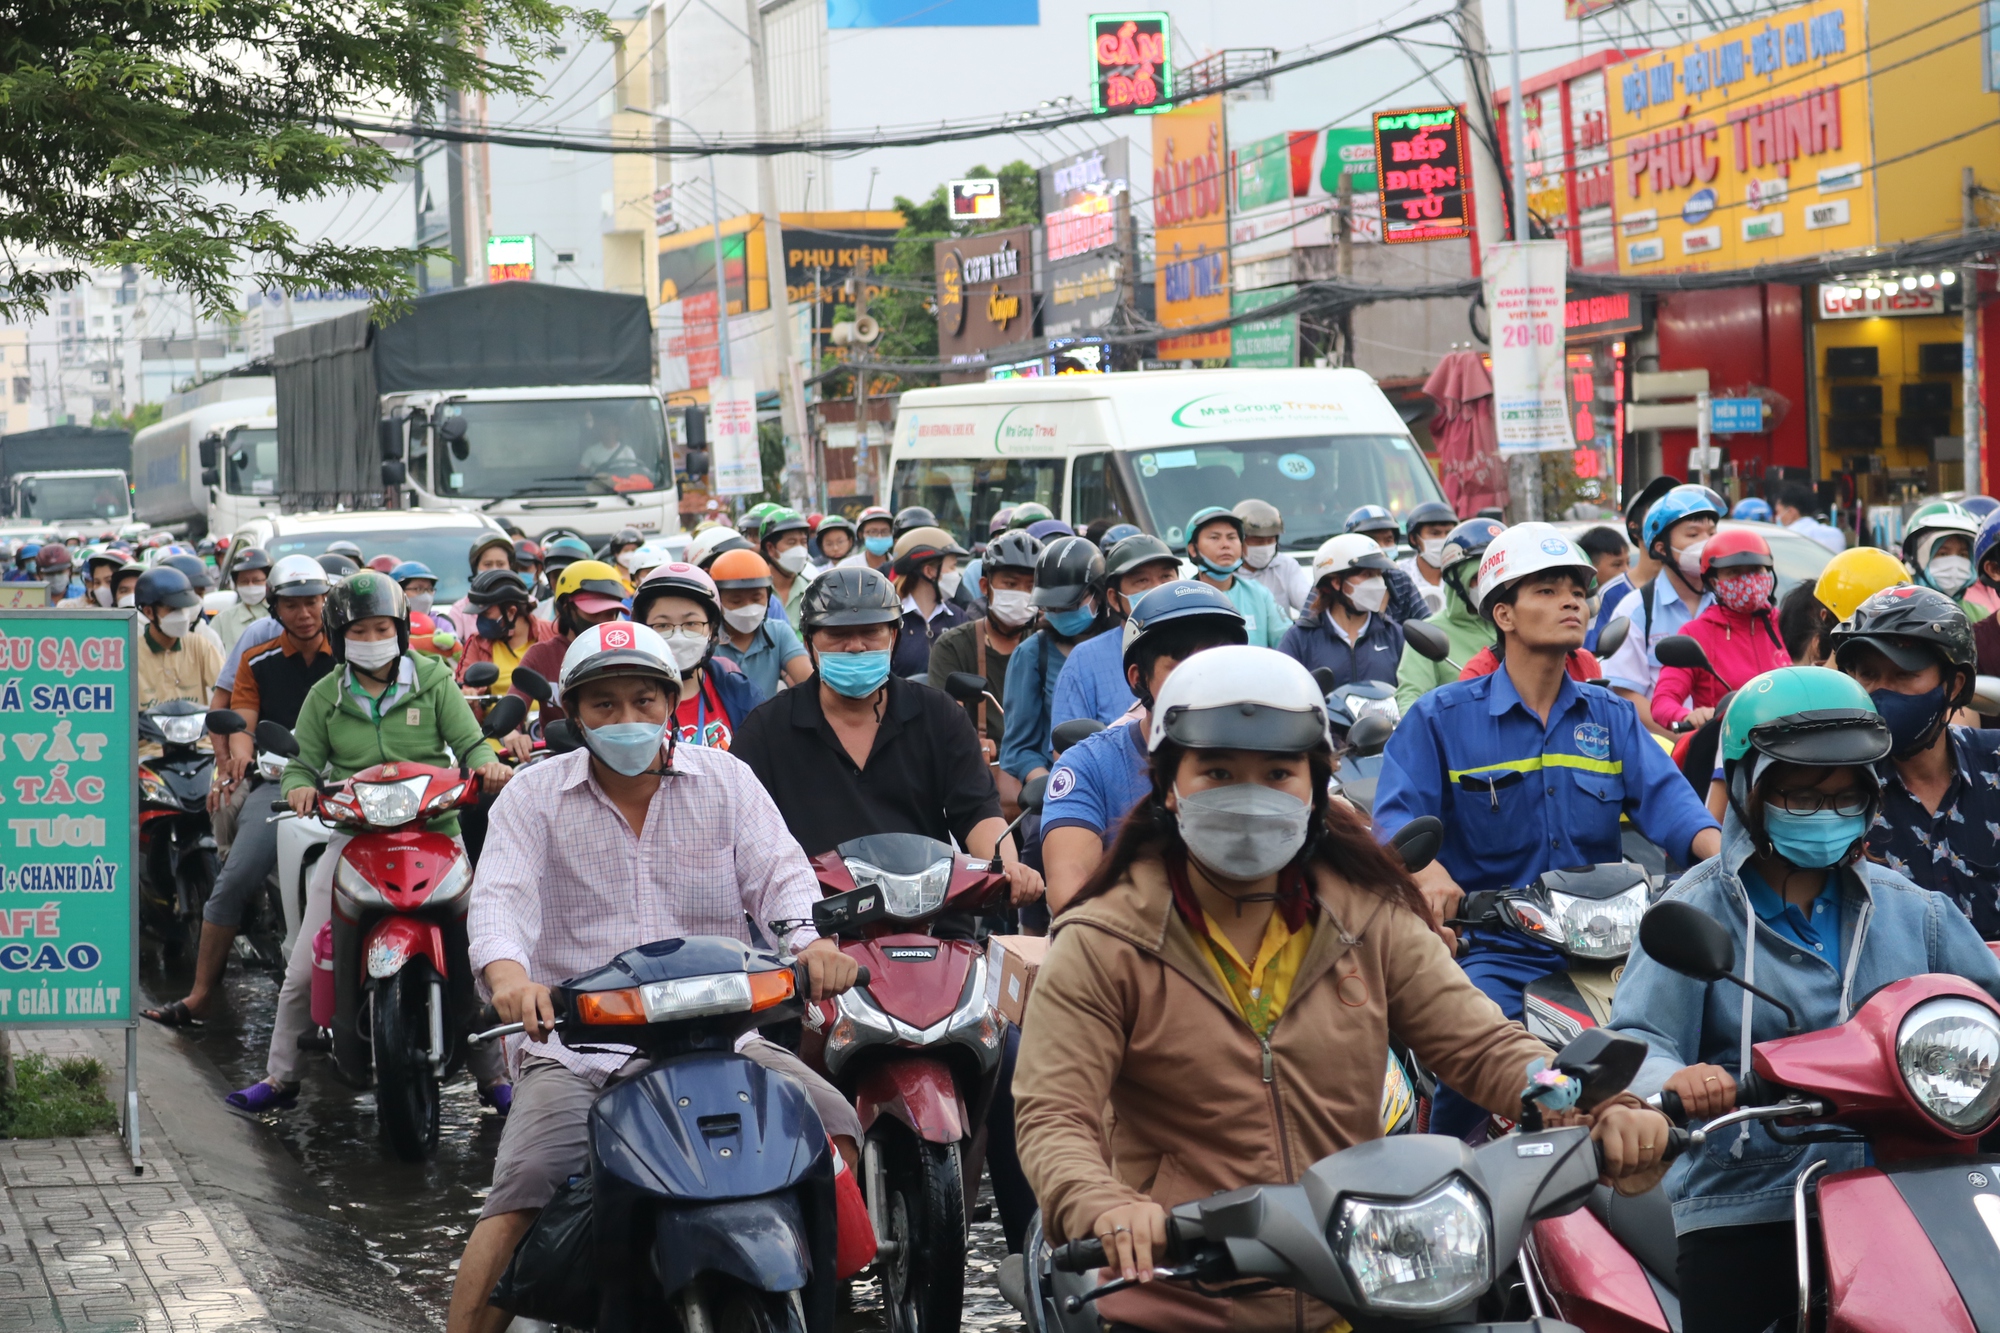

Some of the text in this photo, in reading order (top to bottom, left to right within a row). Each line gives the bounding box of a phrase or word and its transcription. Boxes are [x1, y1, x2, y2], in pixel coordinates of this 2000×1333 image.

[1623, 63, 1649, 119] ĐIỆN
[1651, 54, 1675, 105] MÁY
[1684, 44, 1710, 101] ĐIỆN
[1711, 39, 1745, 97] LẠNH
[1751, 22, 1782, 82] ĐIỆN
[1784, 21, 1808, 66] GIA
[1809, 9, 1846, 68] DỤNG
[1391, 132, 1447, 162] BẾP
[1626, 104, 1719, 198] PHÚC
[1726, 83, 1843, 178] THỊNH
[1153, 136, 1193, 228] CẦM
[1343, 161, 1376, 175] BIKE
[1385, 163, 1457, 193] ĐIỆN
[789, 244, 889, 272] PHỤ KIỆN
[963, 239, 1018, 284] CƠM TẤM
[1502, 323, 1554, 349] 20-10
[1234, 403, 1282, 414] Group
[1283, 401, 1344, 412] Travel
[719, 421, 751, 436] 20-10
[1287, 460, 1308, 475] 38
[1488, 549, 1506, 570] PORT
[38, 636, 125, 678] SẠCH
[0, 677, 115, 718] Á SẠCH
[12, 720, 108, 762] VẮT
[13, 763, 105, 805] TẮC
[8, 813, 105, 848] TƯƠI
[20, 863, 78, 893] CHANH
[79, 855, 119, 893] DÂY
[0, 901, 61, 938] AFÉ
[891, 950, 932, 958] HONDA
[18, 978, 59, 1016] GIẢI
[65, 980, 121, 1015] KHÁT
[801, 1019, 823, 1036] HONDA
